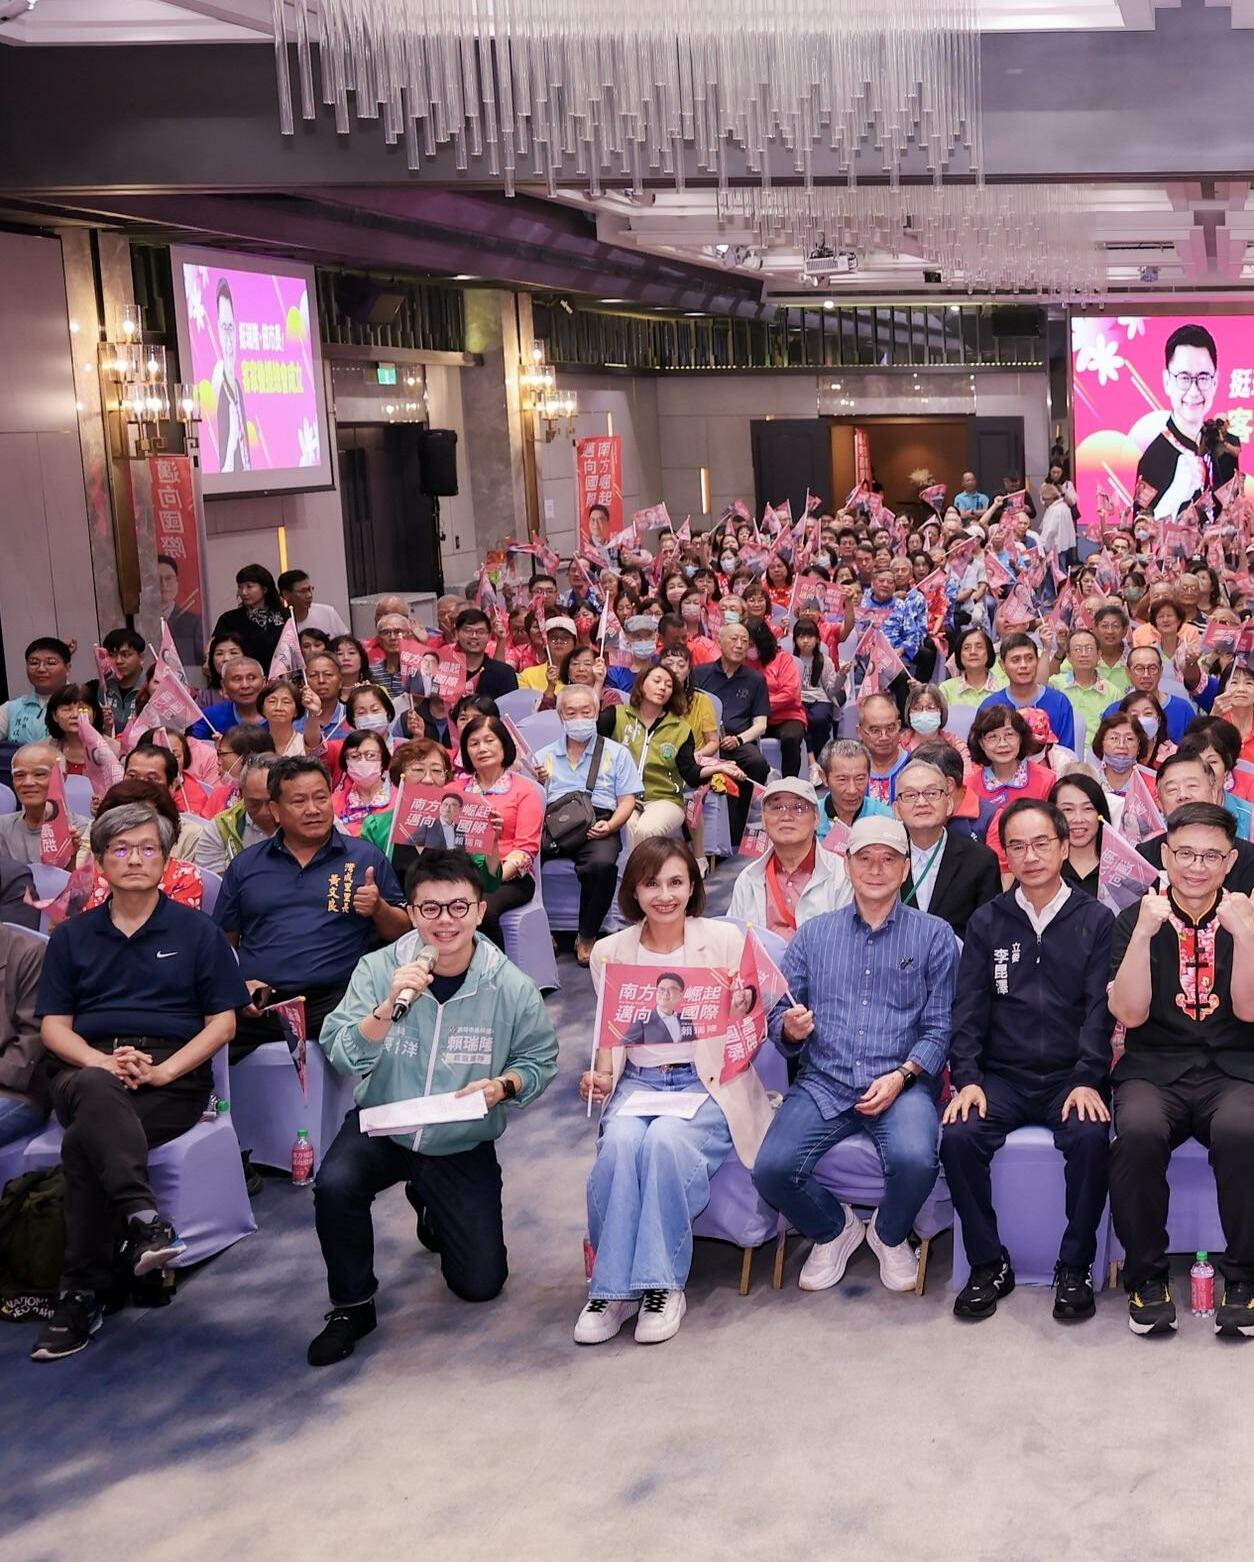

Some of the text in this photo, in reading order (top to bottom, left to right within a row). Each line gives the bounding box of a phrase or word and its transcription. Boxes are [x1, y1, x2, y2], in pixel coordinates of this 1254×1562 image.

[581, 442, 599, 507] 邁向國際
[598, 442, 612, 506] 南方崛起
[411, 798, 492, 818] 南方 崛起
[405, 813, 488, 834] 邁向 國際
[994, 948, 1009, 995] 李昆澤
[619, 983, 723, 1002] 南方 崛起
[614, 1004, 720, 1024] 邁向 國際
[447, 1035, 493, 1052] 賴瑞隆
